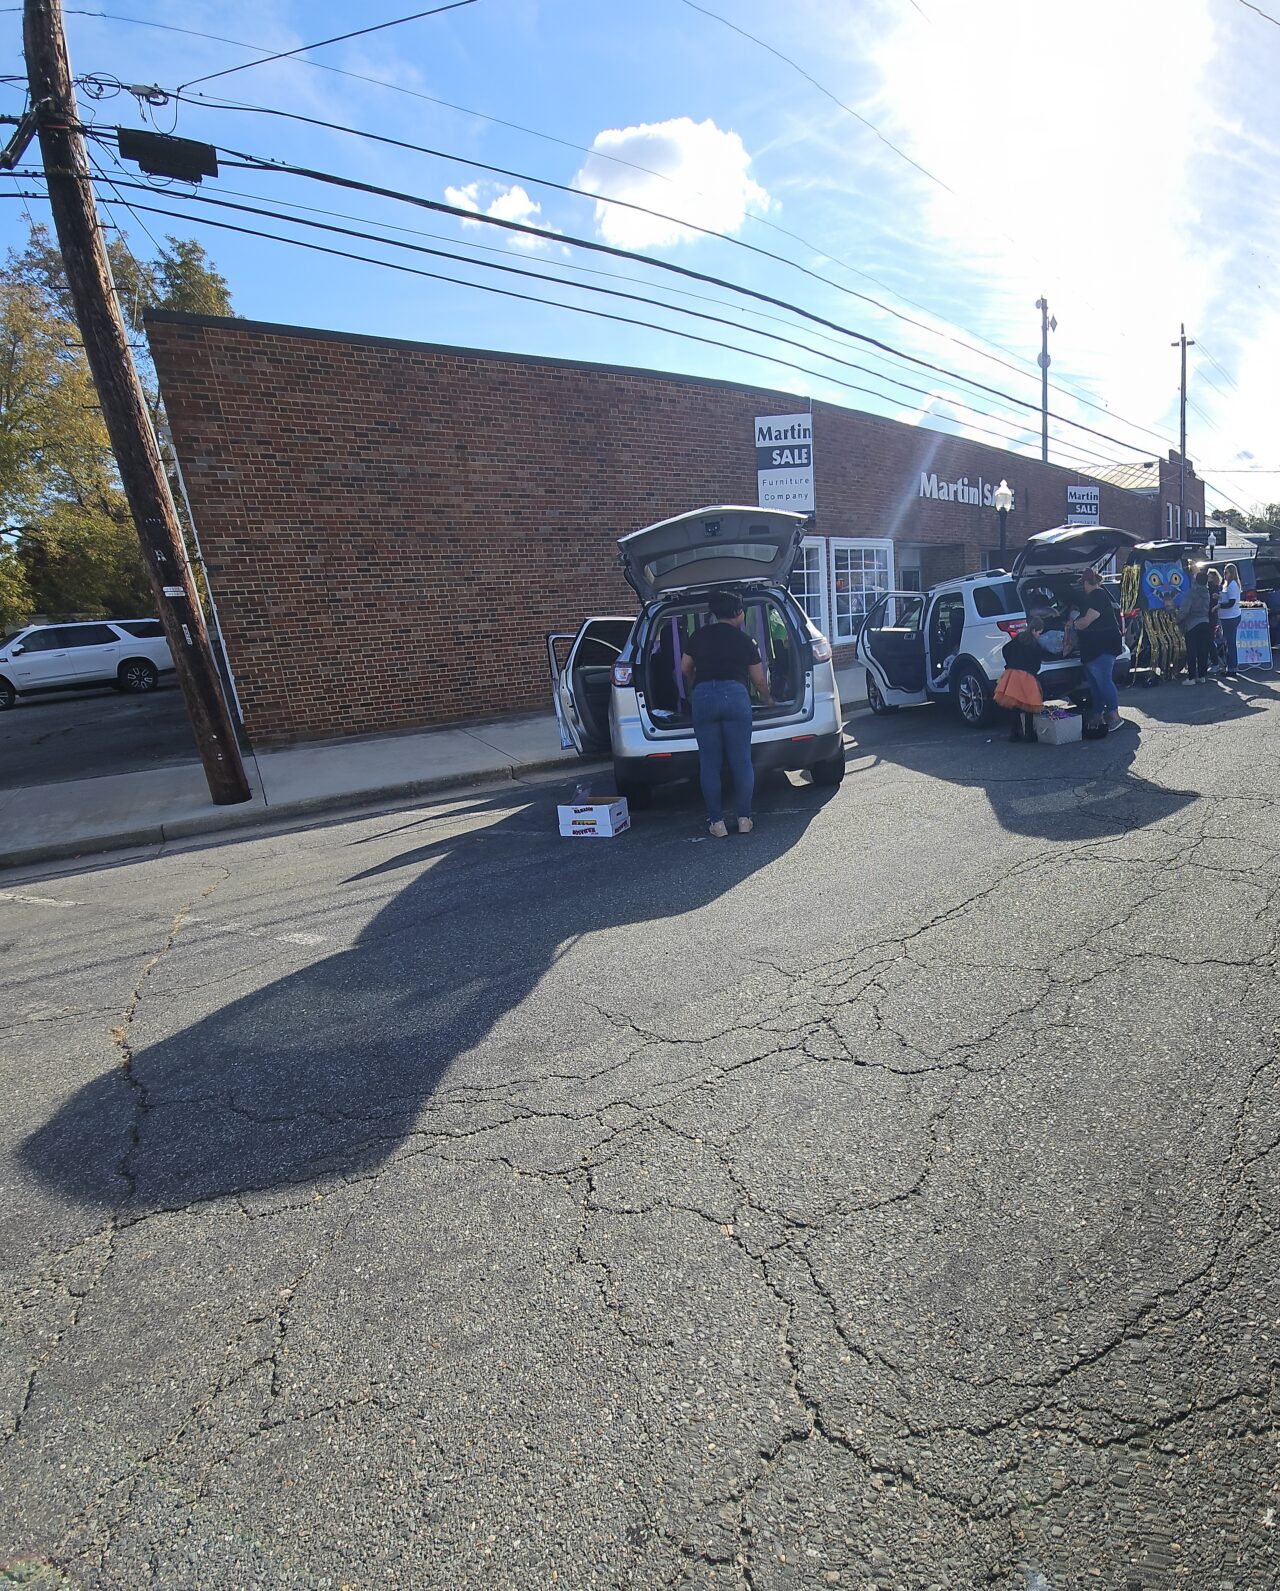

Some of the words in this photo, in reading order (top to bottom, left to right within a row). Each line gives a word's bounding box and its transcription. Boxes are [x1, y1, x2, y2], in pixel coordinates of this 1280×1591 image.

[757, 422, 811, 442] Martin
[772, 448, 808, 465] SALE
[762, 477, 810, 487] Furniture
[919, 471, 978, 505] Martin
[764, 492, 809, 501] Company
[1069, 491, 1098, 501] Martin
[1075, 504, 1097, 514] SALE
[1239, 620, 1268, 630] OOKS
